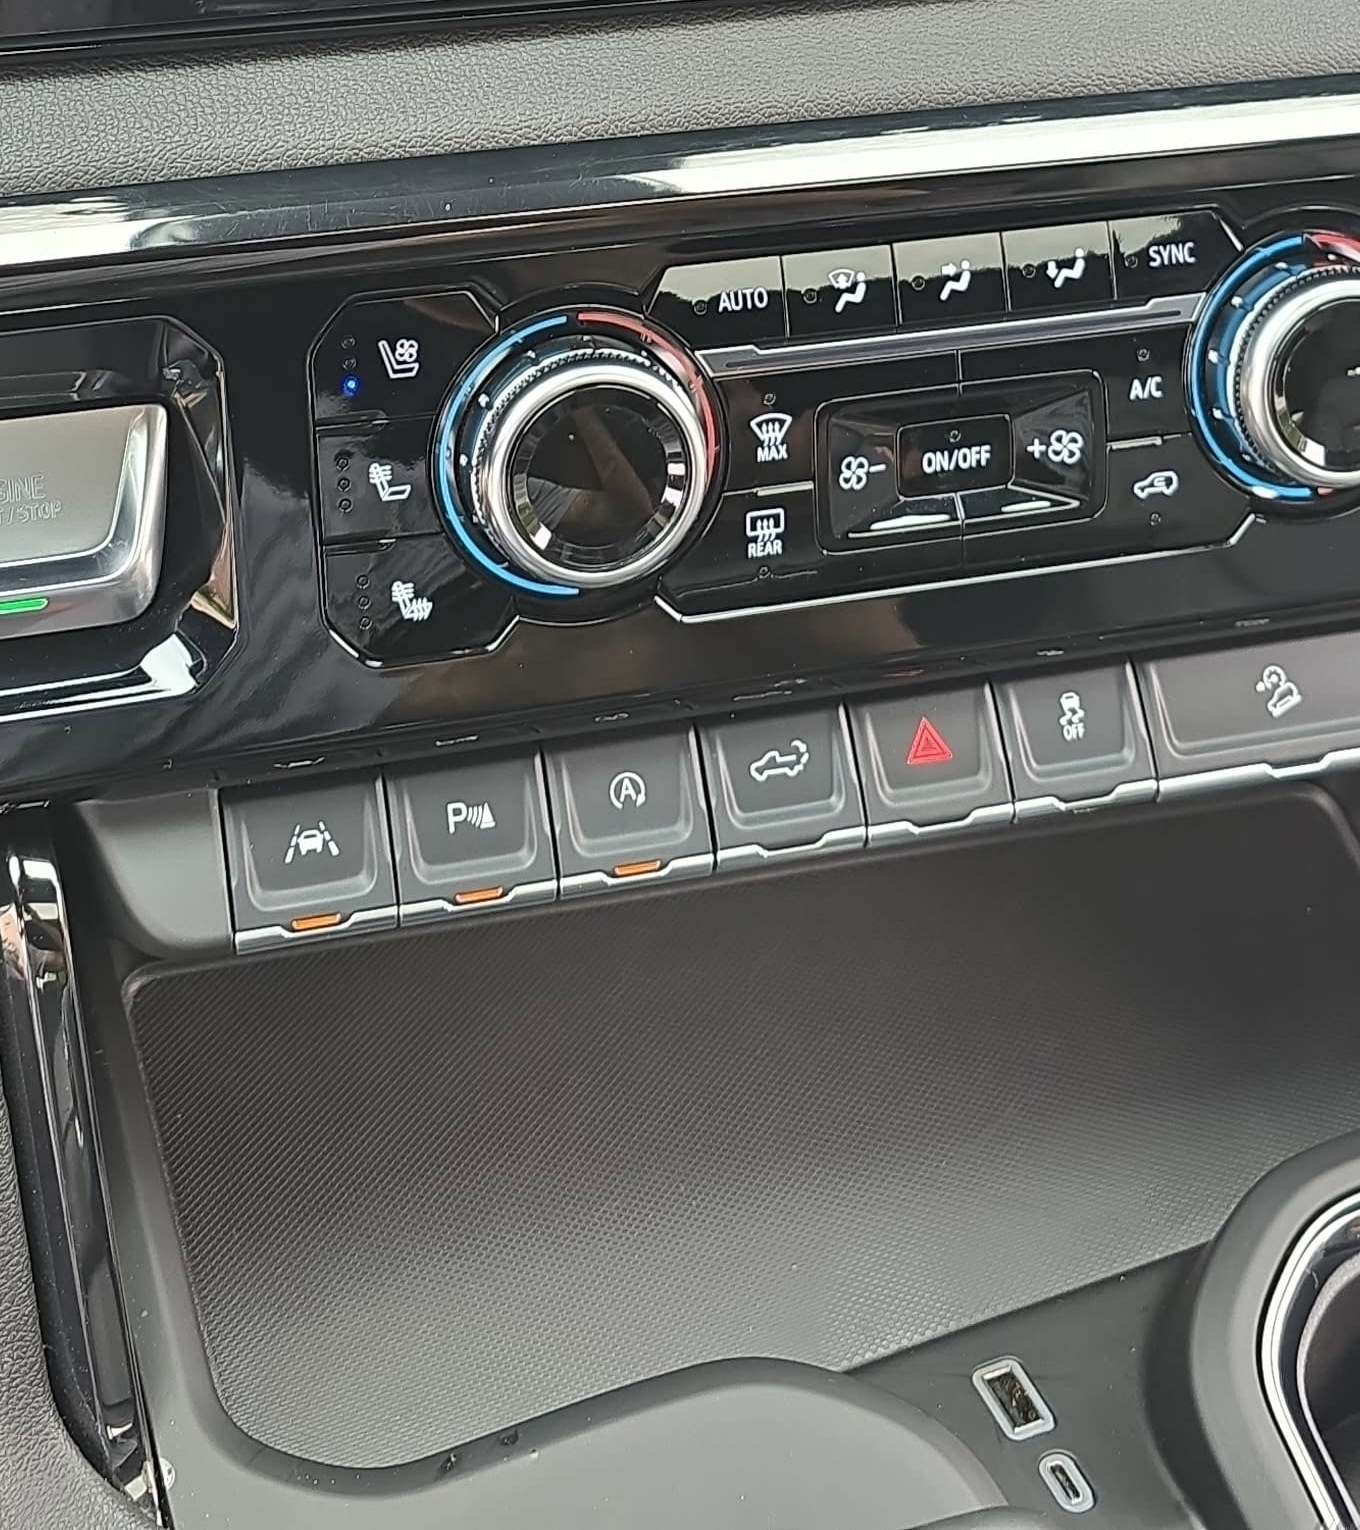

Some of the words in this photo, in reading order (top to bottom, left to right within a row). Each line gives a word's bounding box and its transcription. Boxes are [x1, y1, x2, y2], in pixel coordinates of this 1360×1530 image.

[1144, 237, 1196, 267] SYNC
[715, 284, 772, 313] AUTO
[1129, 376, 1163, 400] A/C
[756, 441, 788, 463] MAX
[922, 444, 991, 474] ON/OFF
[745, 531, 783, 559] REAR
[1061, 717, 1085, 741] OFF
